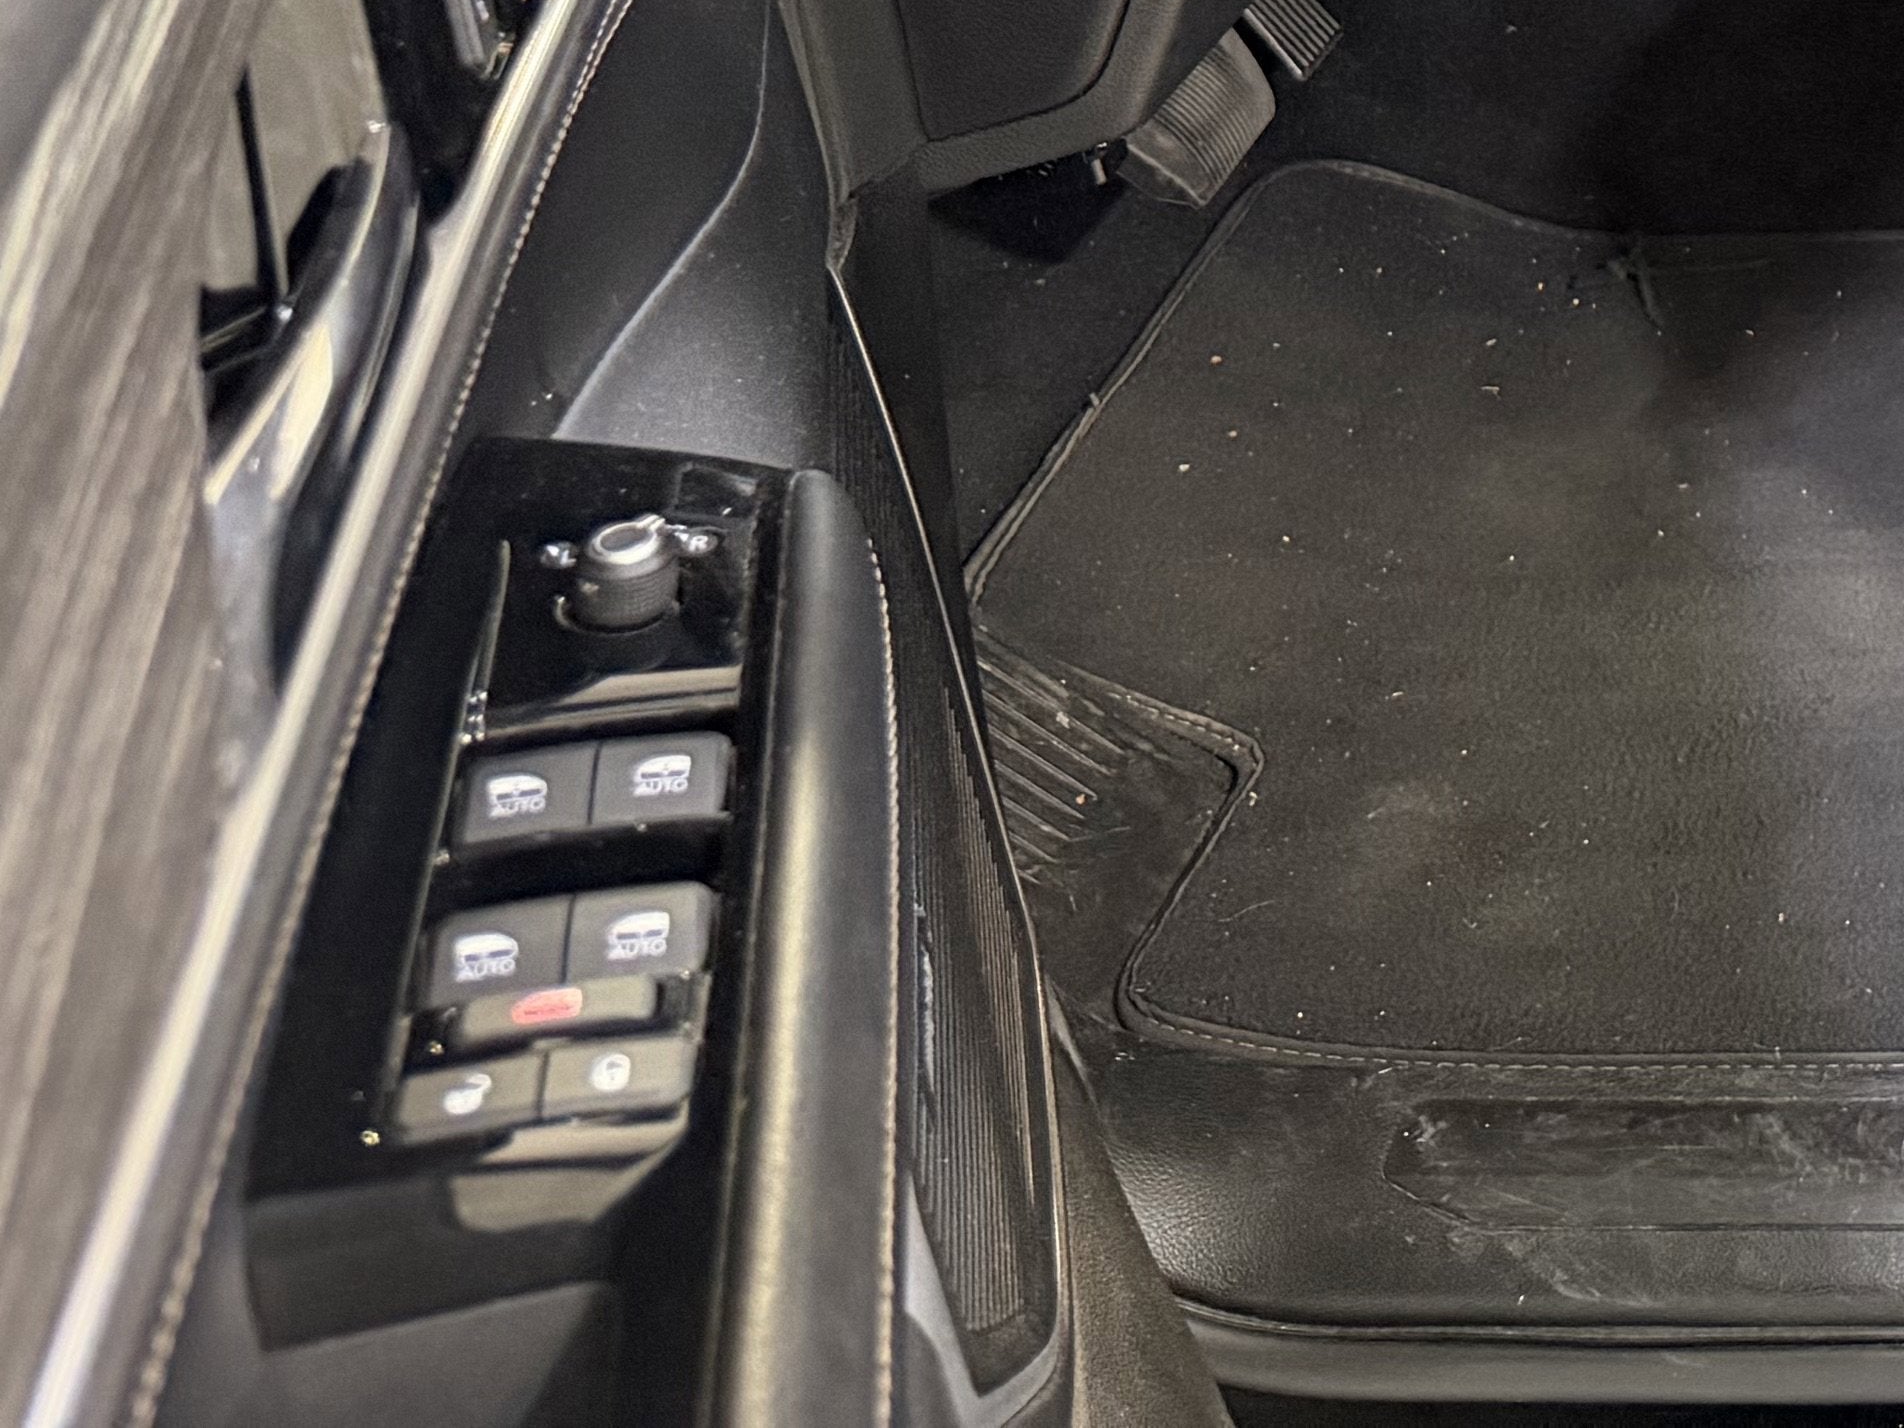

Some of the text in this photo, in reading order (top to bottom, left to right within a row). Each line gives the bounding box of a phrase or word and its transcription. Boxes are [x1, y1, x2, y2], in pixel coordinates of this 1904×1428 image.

[632, 777, 688, 797] AUTO
[489, 796, 546, 818] AUTO
[606, 939, 667, 960] AUTO
[456, 959, 516, 983] AUTO
